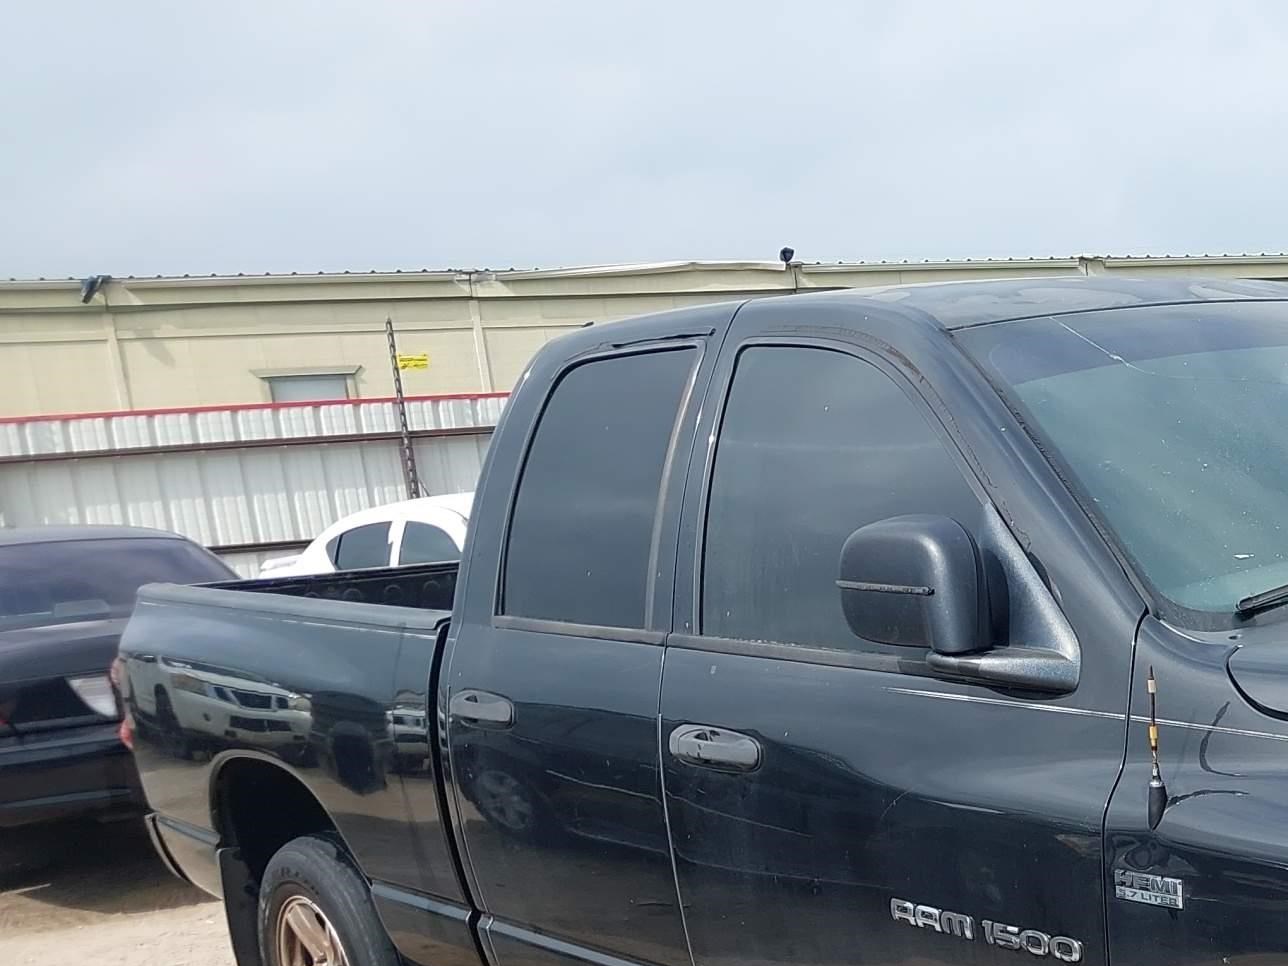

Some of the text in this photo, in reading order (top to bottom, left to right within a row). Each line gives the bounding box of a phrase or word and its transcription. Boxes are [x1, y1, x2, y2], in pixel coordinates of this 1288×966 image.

[1114, 869, 1180, 896] HEMI
[1116, 888, 1179, 907] 5.7 LITER
[890, 897, 1083, 963] RAM 1500
